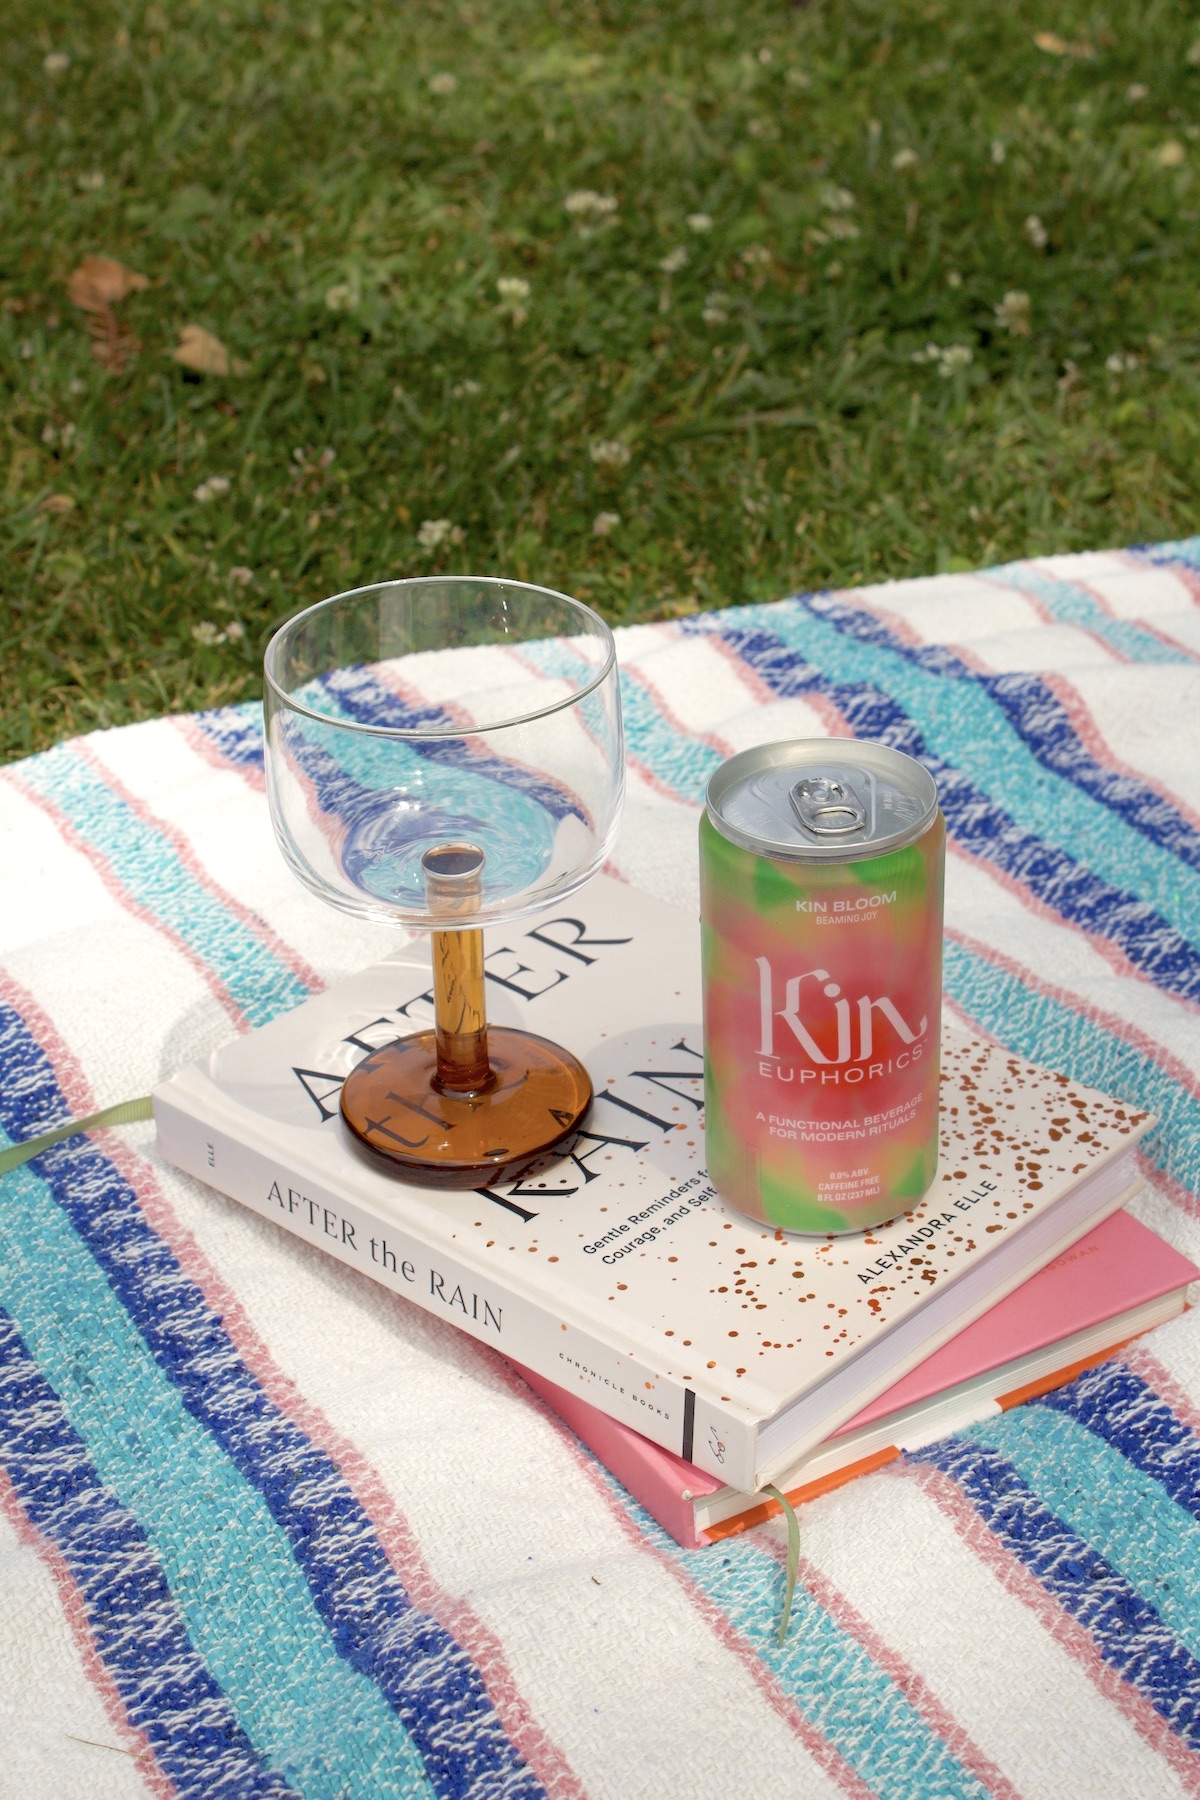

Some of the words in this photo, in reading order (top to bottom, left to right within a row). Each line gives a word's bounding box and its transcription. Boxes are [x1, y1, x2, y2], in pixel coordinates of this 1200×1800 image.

[796, 900, 828, 913] KIN
[833, 890, 897, 913] BLOOM
[816, 914, 860, 925] BEAMING
[861, 910, 878, 922] JOY
[755, 956, 928, 1065] Kin
[759, 1043, 923, 1085] EUPHORICS
[363, 1055, 530, 1149] th
[756, 1112, 766, 1122] A
[769, 1115, 861, 1131] FUNCTIONAL
[864, 1093, 923, 1126] BEVERAGE
[769, 1127, 797, 1140] FOR
[801, 1129, 866, 1142] MODERN
[869, 1109, 917, 1136] RITUALS
[818, 1180, 859, 1191] CAFFEINE
[860, 1176, 880, 1186] FREE
[824, 1193, 834, 1201] FL
[835, 1193, 847, 1201] OZ
[847, 1190, 864, 1201] (237
[865, 1186, 880, 1197] ML)
[829, 1171, 850, 1180] 0.0%
[851, 1168, 869, 1177] ABV
[583, 1224, 631, 1255] Gentle
[627, 1177, 701, 1225] Reminders
[602, 1226, 668, 1265] Courage,
[663, 1205, 691, 1226] and
[857, 1211, 957, 1285] ALEXANDRA
[953, 1179, 998, 1212] ELLE
[266, 1180, 357, 1251] AFTER
[369, 1237, 416, 1282] the
[429, 1269, 503, 1333] RAIN
[559, 1352, 625, 1394] CHRONICLE
[632, 1394, 670, 1421] BOOKS
